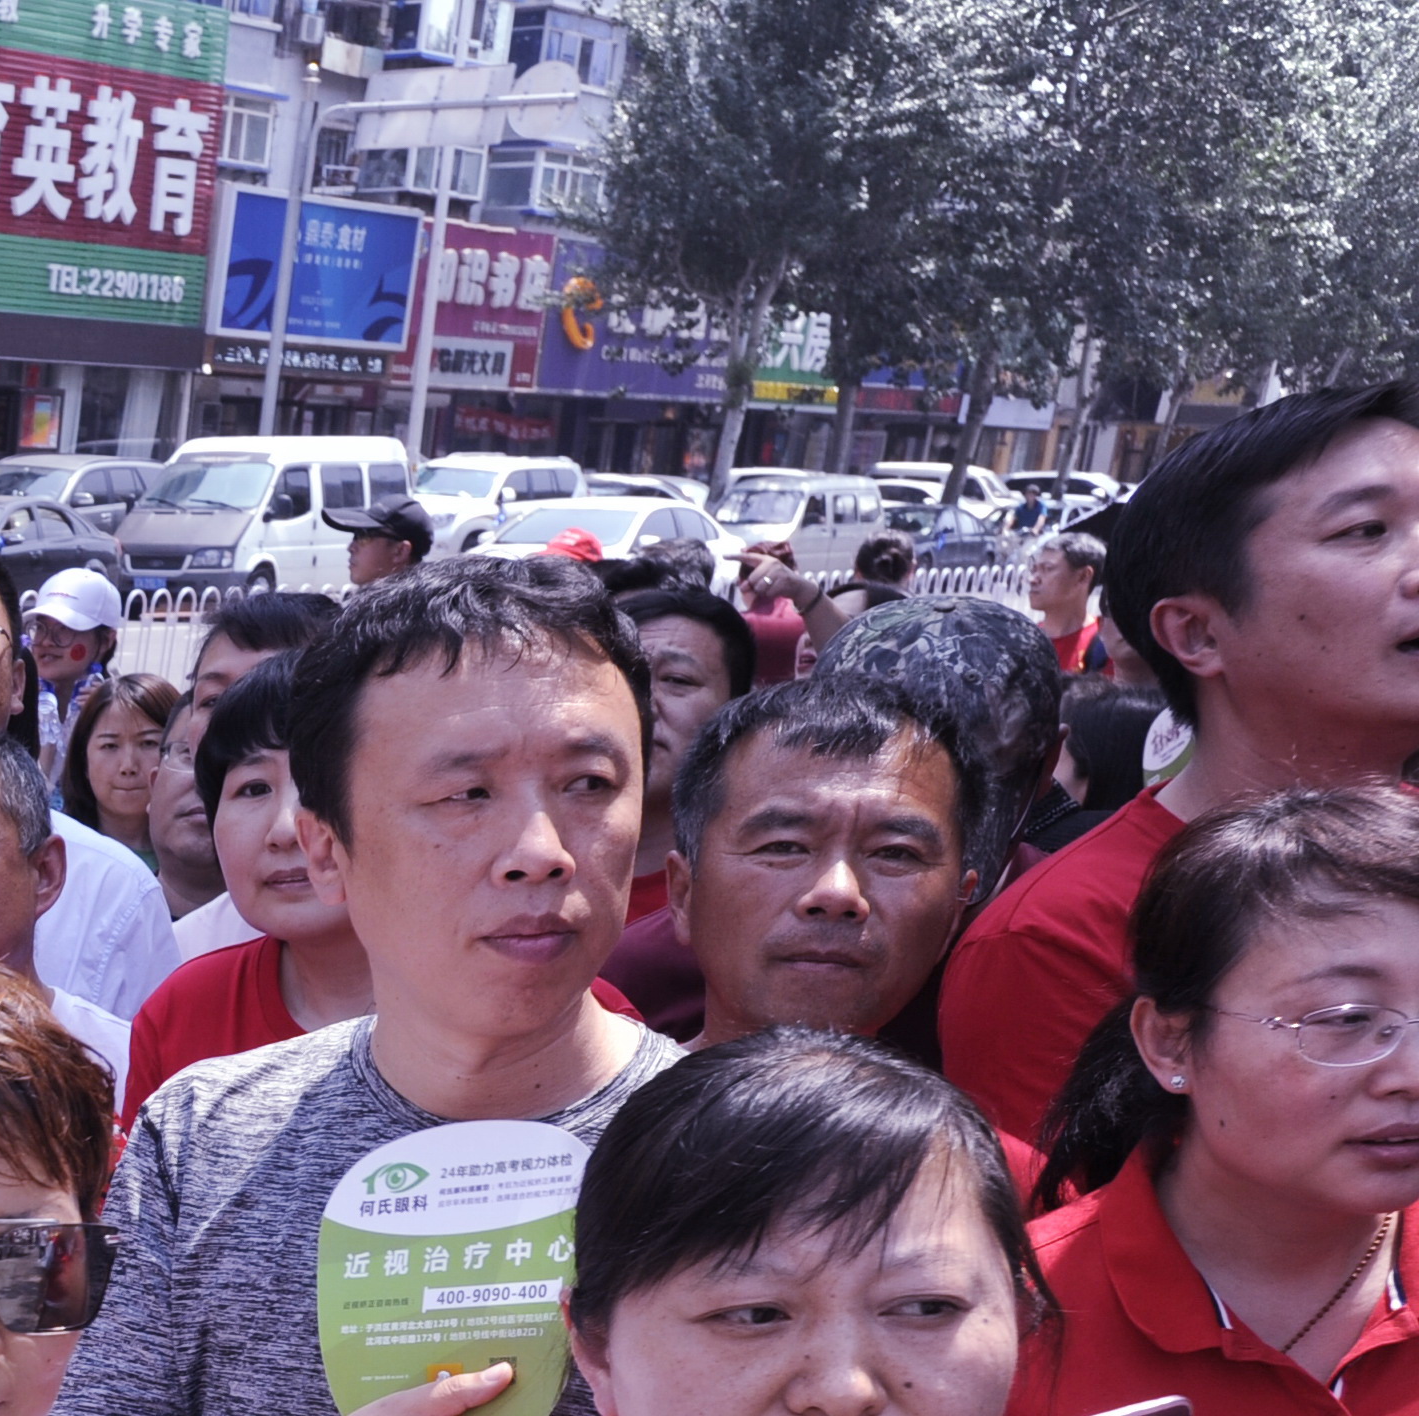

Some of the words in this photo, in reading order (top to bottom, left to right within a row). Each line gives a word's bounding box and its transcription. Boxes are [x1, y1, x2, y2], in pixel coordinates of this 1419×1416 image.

[92, 3, 203, 59] 升学专家
[48, 263, 185, 304] TEL:22901186
[440, 1153, 572, 1179] 24年助力高考视力体检
[359, 1195, 429, 1218] 何氏眼科
[343, 1234, 575, 1280] 近视治疗中心
[436, 1284, 548, 1305] 400-9090-400
